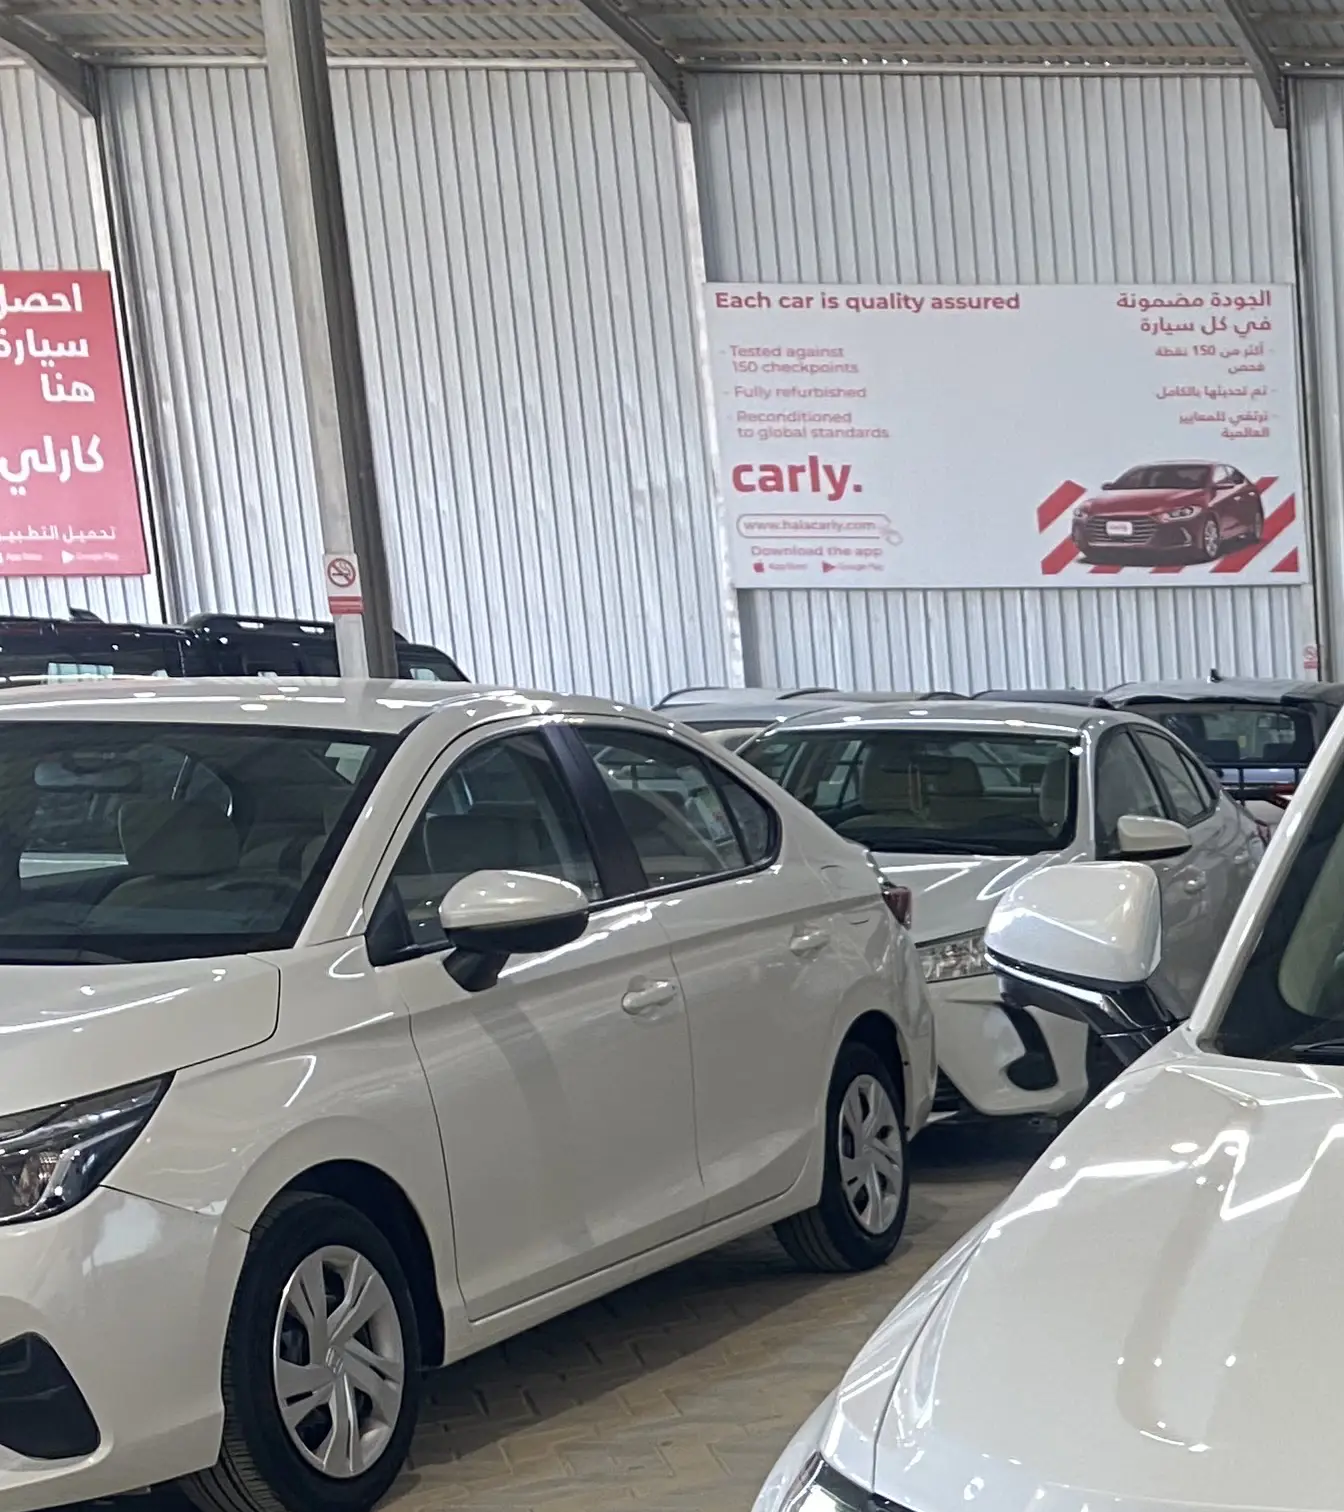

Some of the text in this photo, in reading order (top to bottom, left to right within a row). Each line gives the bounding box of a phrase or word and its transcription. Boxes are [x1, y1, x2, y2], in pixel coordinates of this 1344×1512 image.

[715, 291, 1020, 313] Each car is quality assured
[1116, 289, 1272, 311] الجودة مضمونة
[1140, 315, 1272, 337] في كل سيارة
[730, 345, 844, 360] Tested against
[1192, 344, 1216, 356] 150
[1219, 347, 1240, 358] من
[732, 361, 859, 375] 150 checkpoints
[40, 372, 95, 402] هنا
[734, 385, 867, 399] Fully refurbished
[737, 410, 852, 423] Reconditioned
[738, 426, 890, 440] to global standards
[0, 434, 104, 496] كارلي
[732, 454, 863, 502] carly.
[743, 519, 876, 533] www.halacarly.com
[0, 525, 117, 544] تحميل التطبي
[750, 545, 882, 559] Download the app
